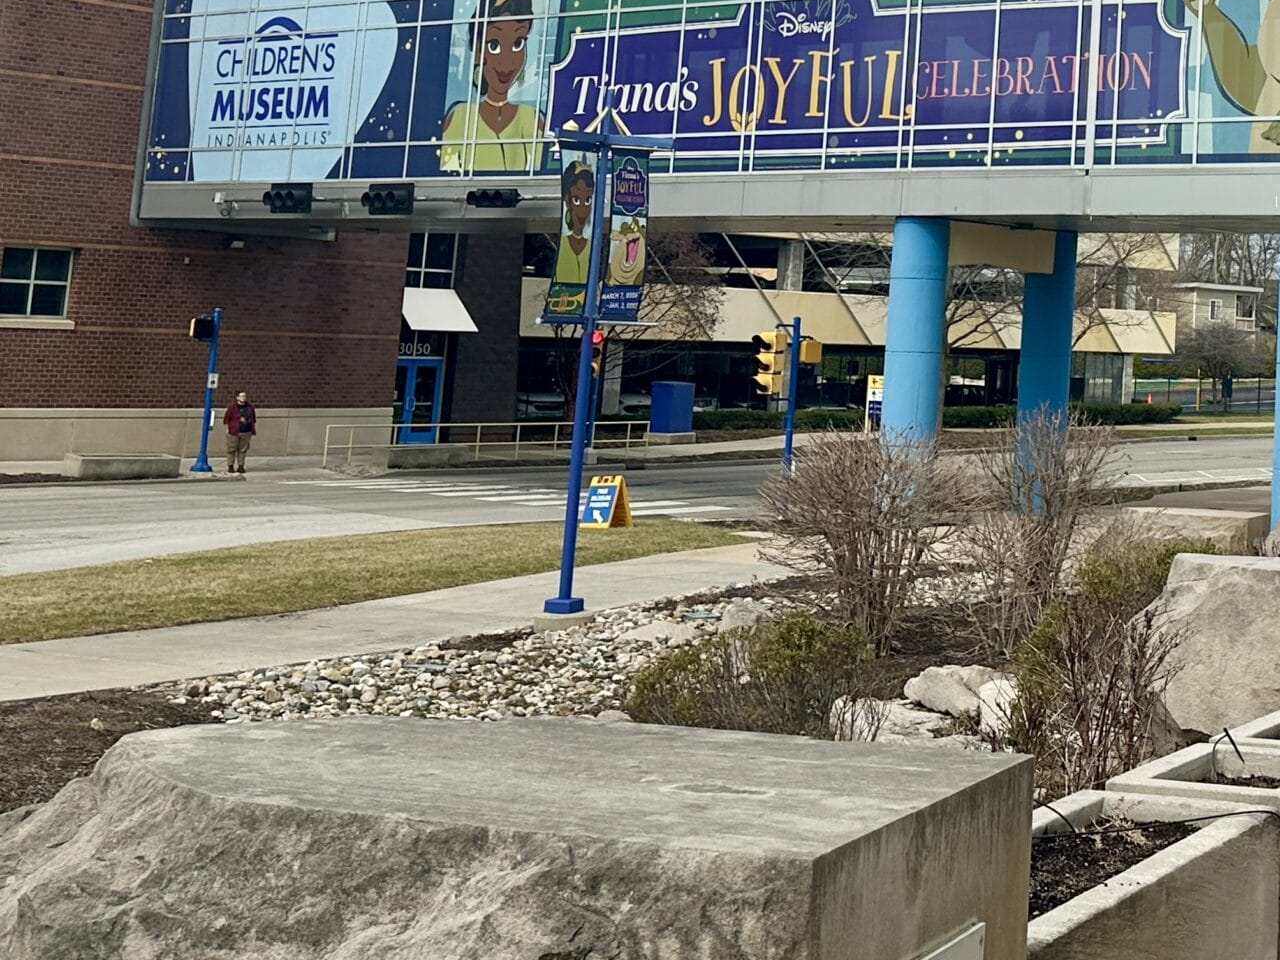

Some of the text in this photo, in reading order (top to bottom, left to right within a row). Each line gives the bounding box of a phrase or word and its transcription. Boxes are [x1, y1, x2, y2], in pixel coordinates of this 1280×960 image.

[216, 42, 337, 78] CHILDREN'S
[210, 85, 330, 122] MUSEUM
[572, 47, 1155, 133] Tiana's JOYFUL CELEBRATION
[399, 342, 431, 355] 3050
